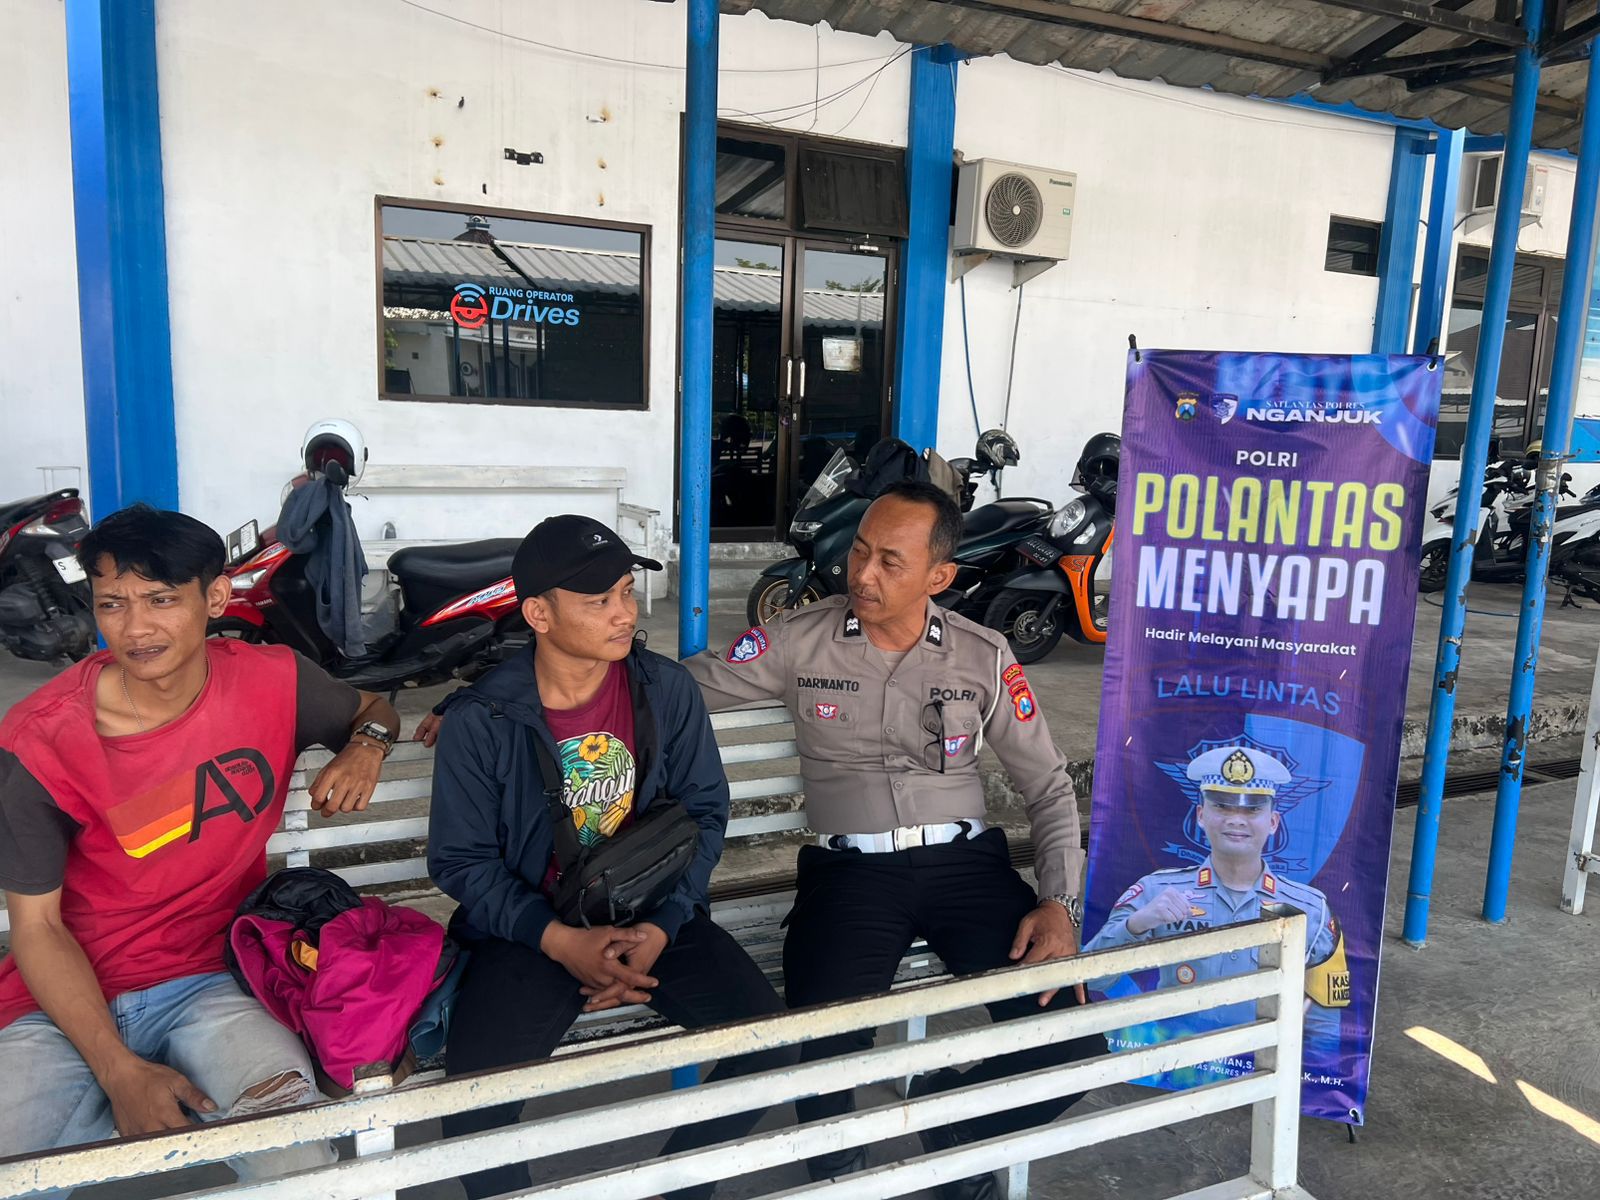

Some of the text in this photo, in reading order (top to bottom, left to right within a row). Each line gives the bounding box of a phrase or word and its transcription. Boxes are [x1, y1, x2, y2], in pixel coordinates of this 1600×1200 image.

[489, 287, 573, 302] RUANG OPERATOR
[491, 297, 580, 326] Drives
[1246, 407, 1383, 425] NGANJUK
[1235, 450, 1298, 468] POLRI
[1132, 472, 1405, 550] POLANTAS
[1136, 545, 1385, 626] MENYAPA
[1145, 627, 1357, 657] Hadir Melayani Masyarakat
[797, 677, 860, 693] DARWANTO
[929, 687, 977, 702] POLRI
[1157, 674, 1343, 716] LALU LINTAS
[1209, 1065, 1239, 1077] POLRES
